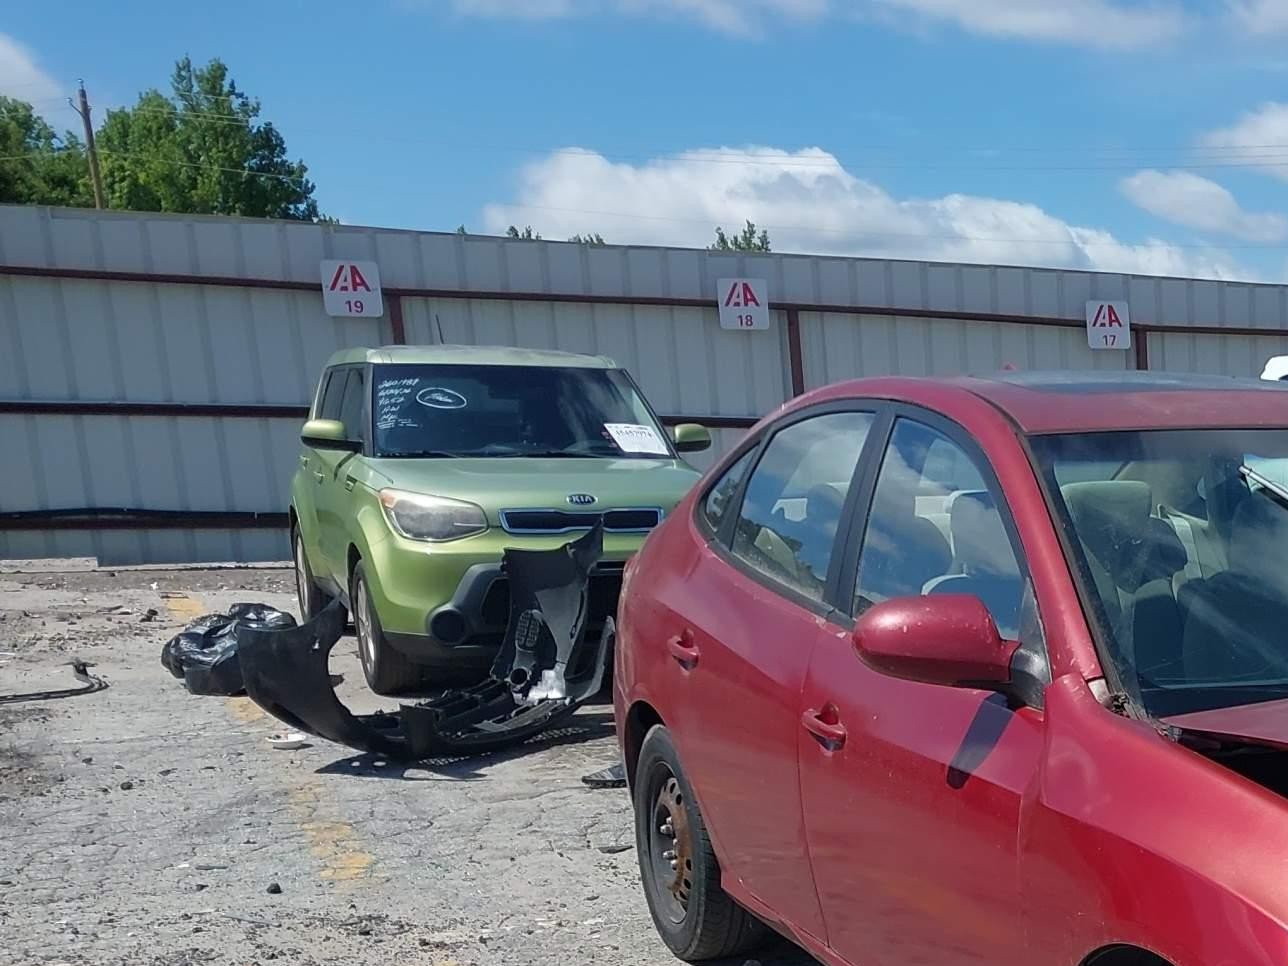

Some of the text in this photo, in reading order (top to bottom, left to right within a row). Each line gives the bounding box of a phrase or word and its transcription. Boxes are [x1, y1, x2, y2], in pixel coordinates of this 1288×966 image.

[344, 300, 364, 314] 19
[737, 314, 754, 327] 18
[1102, 334, 1116, 346] 17
